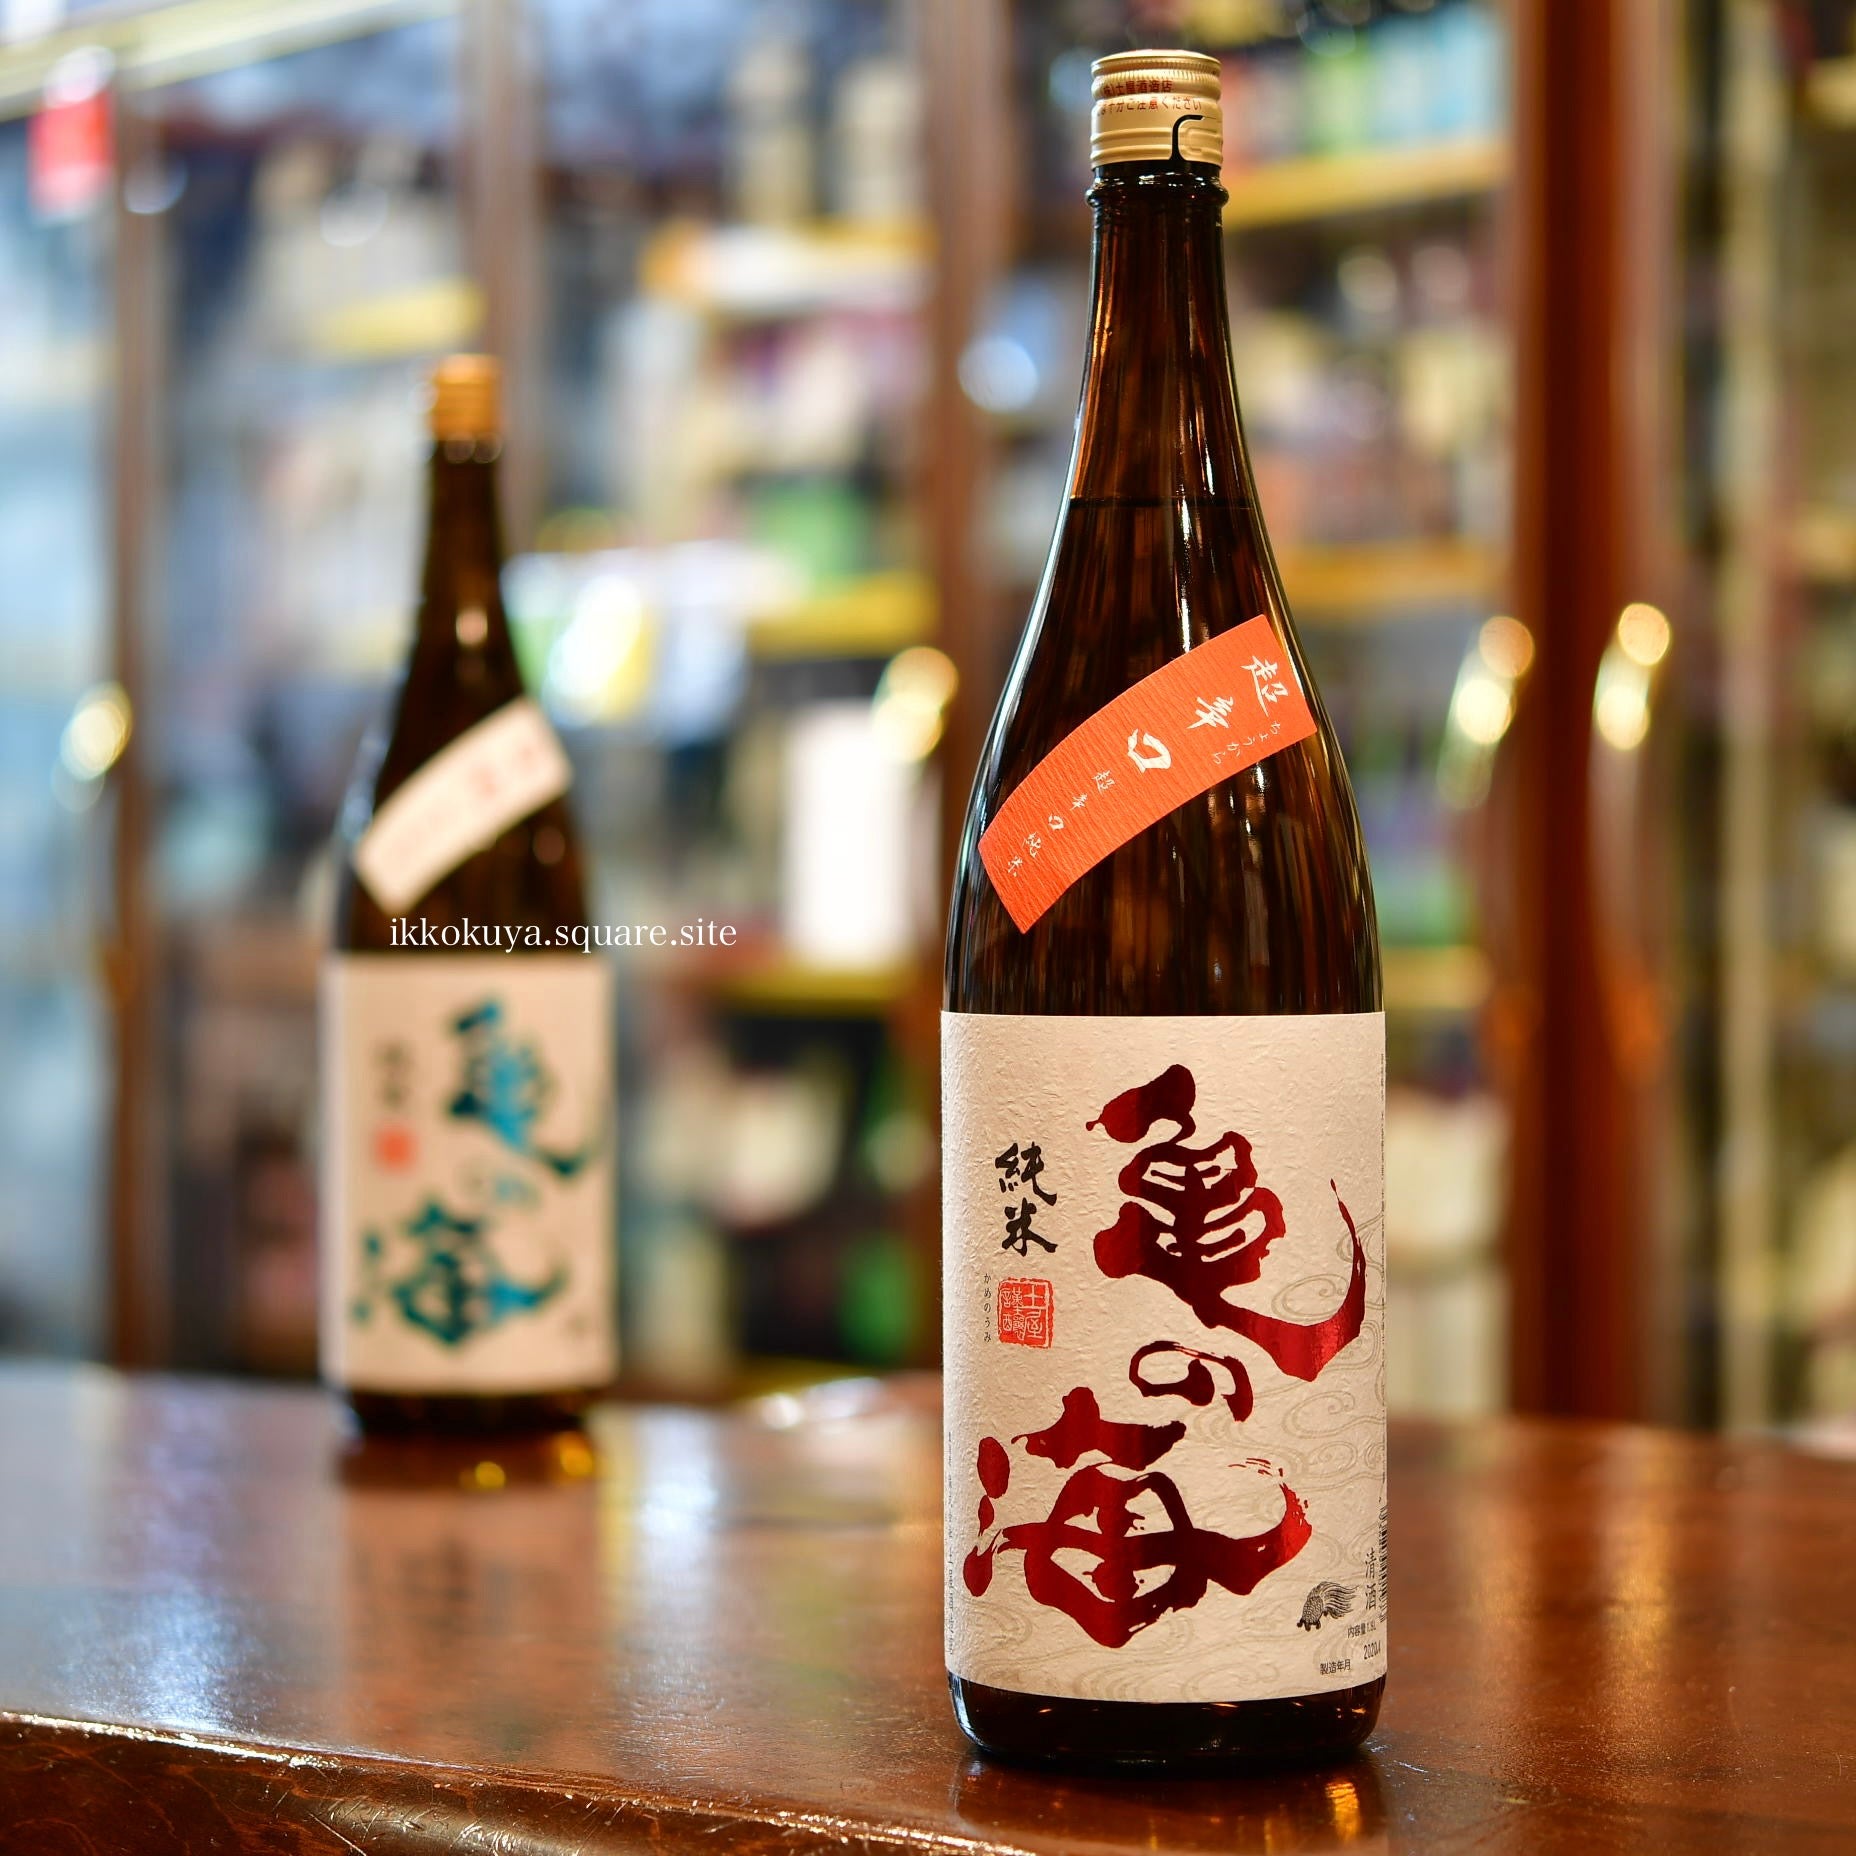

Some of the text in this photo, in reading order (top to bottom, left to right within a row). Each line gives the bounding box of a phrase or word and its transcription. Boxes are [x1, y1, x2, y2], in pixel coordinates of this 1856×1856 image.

[1126, 655, 1289, 773] 超辛口
[1212, 720, 1281, 765] ちょうから
[994, 1141, 1058, 1257] 純米
[983, 1272, 992, 1343] かめのうみ
[963, 1064, 1367, 1649] 亀の海
[1365, 1547, 1377, 1611] 清酒
[1320, 1659, 1351, 1675] 製造年月
